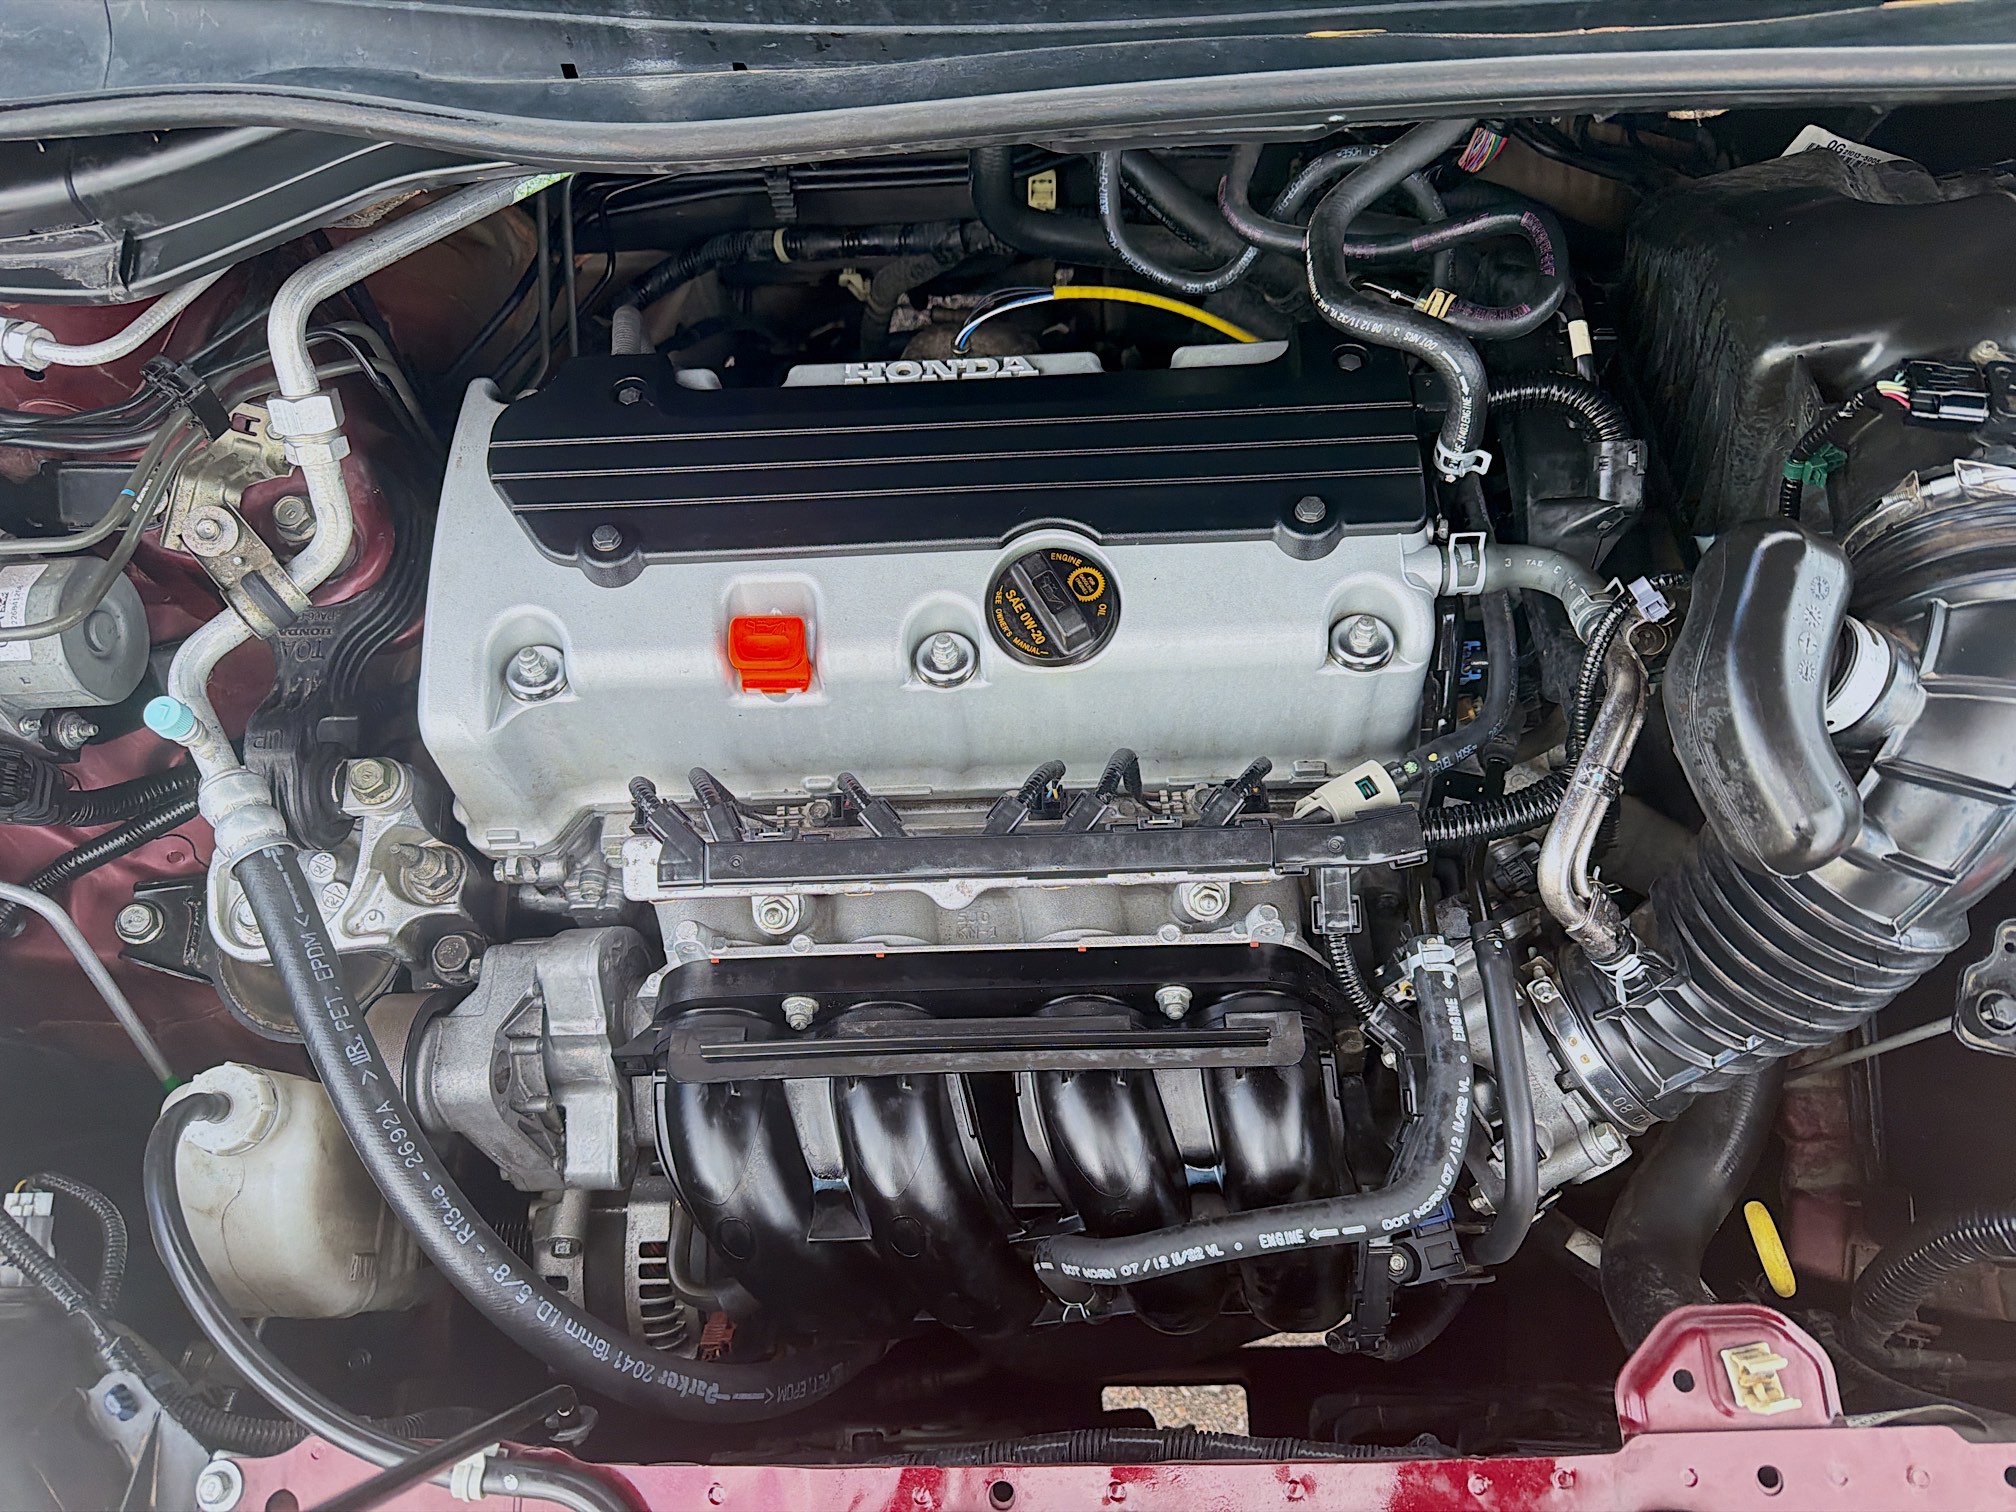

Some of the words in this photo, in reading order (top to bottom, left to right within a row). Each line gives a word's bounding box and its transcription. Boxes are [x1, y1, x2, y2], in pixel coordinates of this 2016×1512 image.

[1419, 338, 1438, 350] DOT
[844, 356, 1040, 385] HONDA
[1460, 396, 1473, 424] ENGINE
[1050, 552, 1083, 567] ENGINE
[995, 608, 1013, 637] OWNER'S
[1005, 589, 1026, 614] SAE
[1020, 612, 1046, 645] 0W-20
[1097, 603, 1107, 617] OIL
[277, 627, 333, 638] HONDA
[300, 931, 335, 983] EPDM
[1446, 997, 1467, 1043] ENGINE
[1457, 1076, 1471, 1094] VL
[375, 1099, 424, 1169] 2692A
[431, 1184, 476, 1245] R134a
[1381, 1214, 1411, 1232] DOT
[1258, 1228, 1306, 1250] ENGINE
[564, 1317, 612, 1362] 16mm
[613, 1350, 656, 1383] 2041
[658, 1368, 720, 1405] Parker
